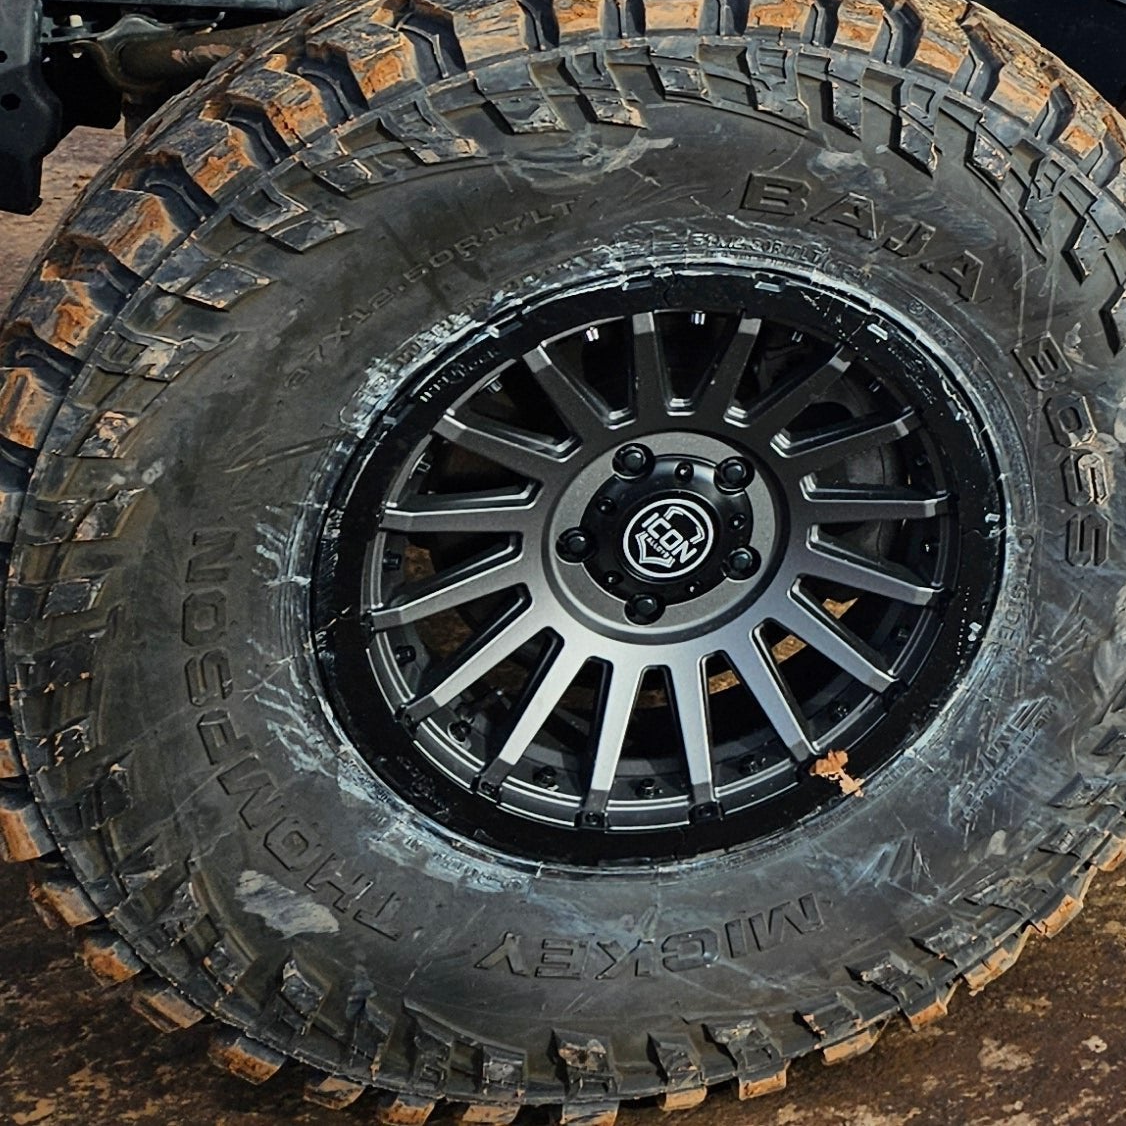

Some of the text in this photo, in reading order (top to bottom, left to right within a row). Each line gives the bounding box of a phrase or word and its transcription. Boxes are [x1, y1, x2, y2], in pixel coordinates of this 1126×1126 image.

[642, 513, 697, 563] ICON
[739, 172, 985, 303] BAJA
[1013, 330, 1111, 568] BOSS
[180, 527, 833, 982] MICKEY THOMPSON
